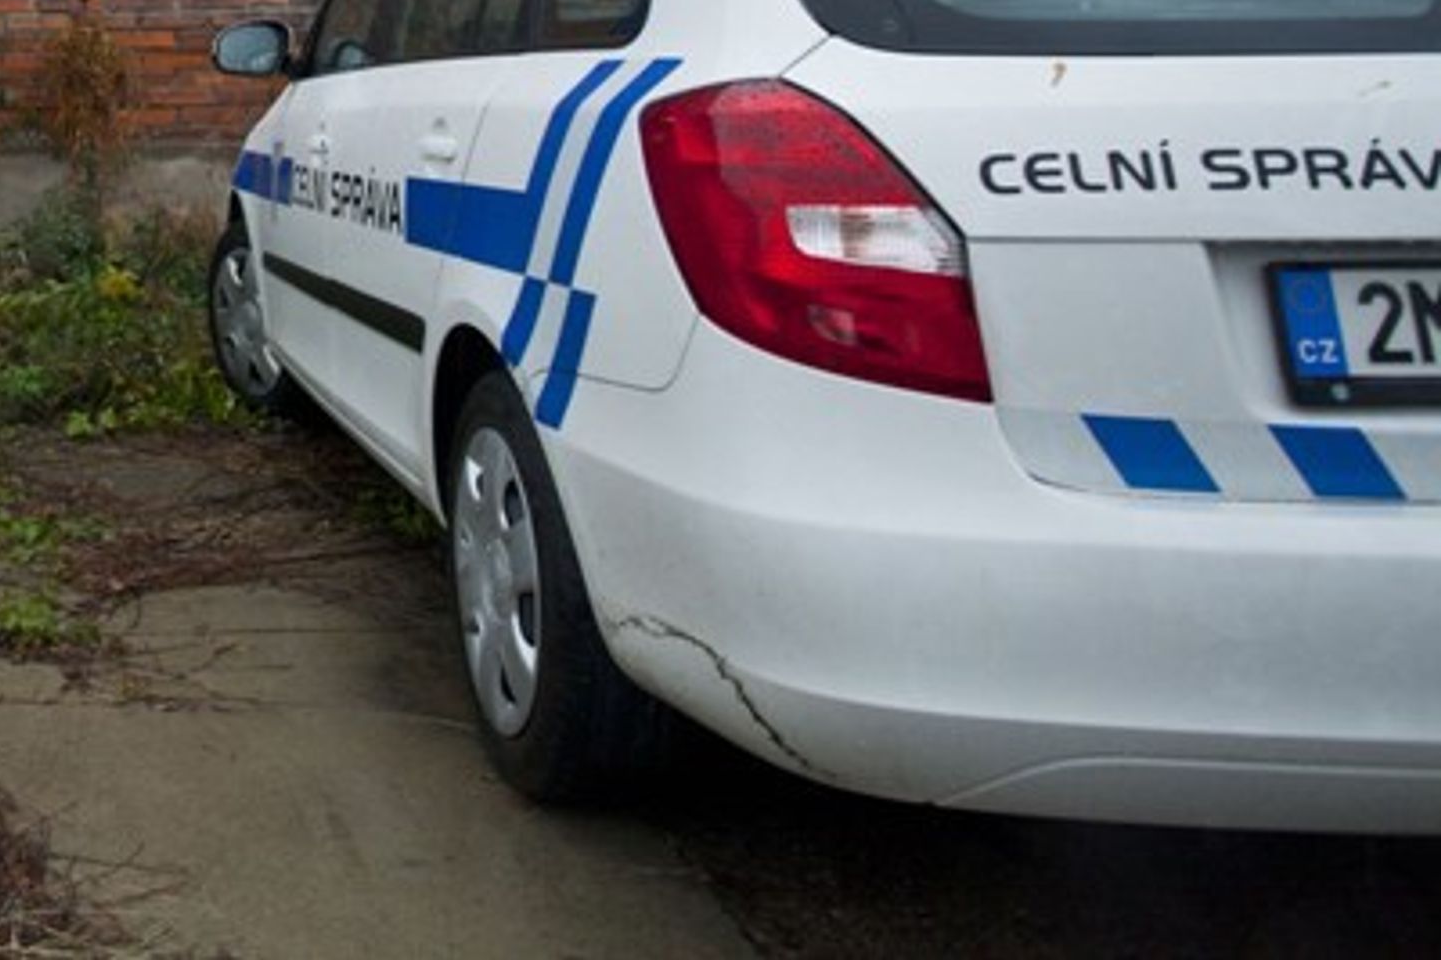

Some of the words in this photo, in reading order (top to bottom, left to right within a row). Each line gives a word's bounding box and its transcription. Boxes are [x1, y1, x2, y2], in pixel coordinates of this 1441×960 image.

[979, 140, 1178, 195] CELNÍ
[330, 167, 404, 235] SPRÁVA
[1297, 339, 1340, 365] CZ
